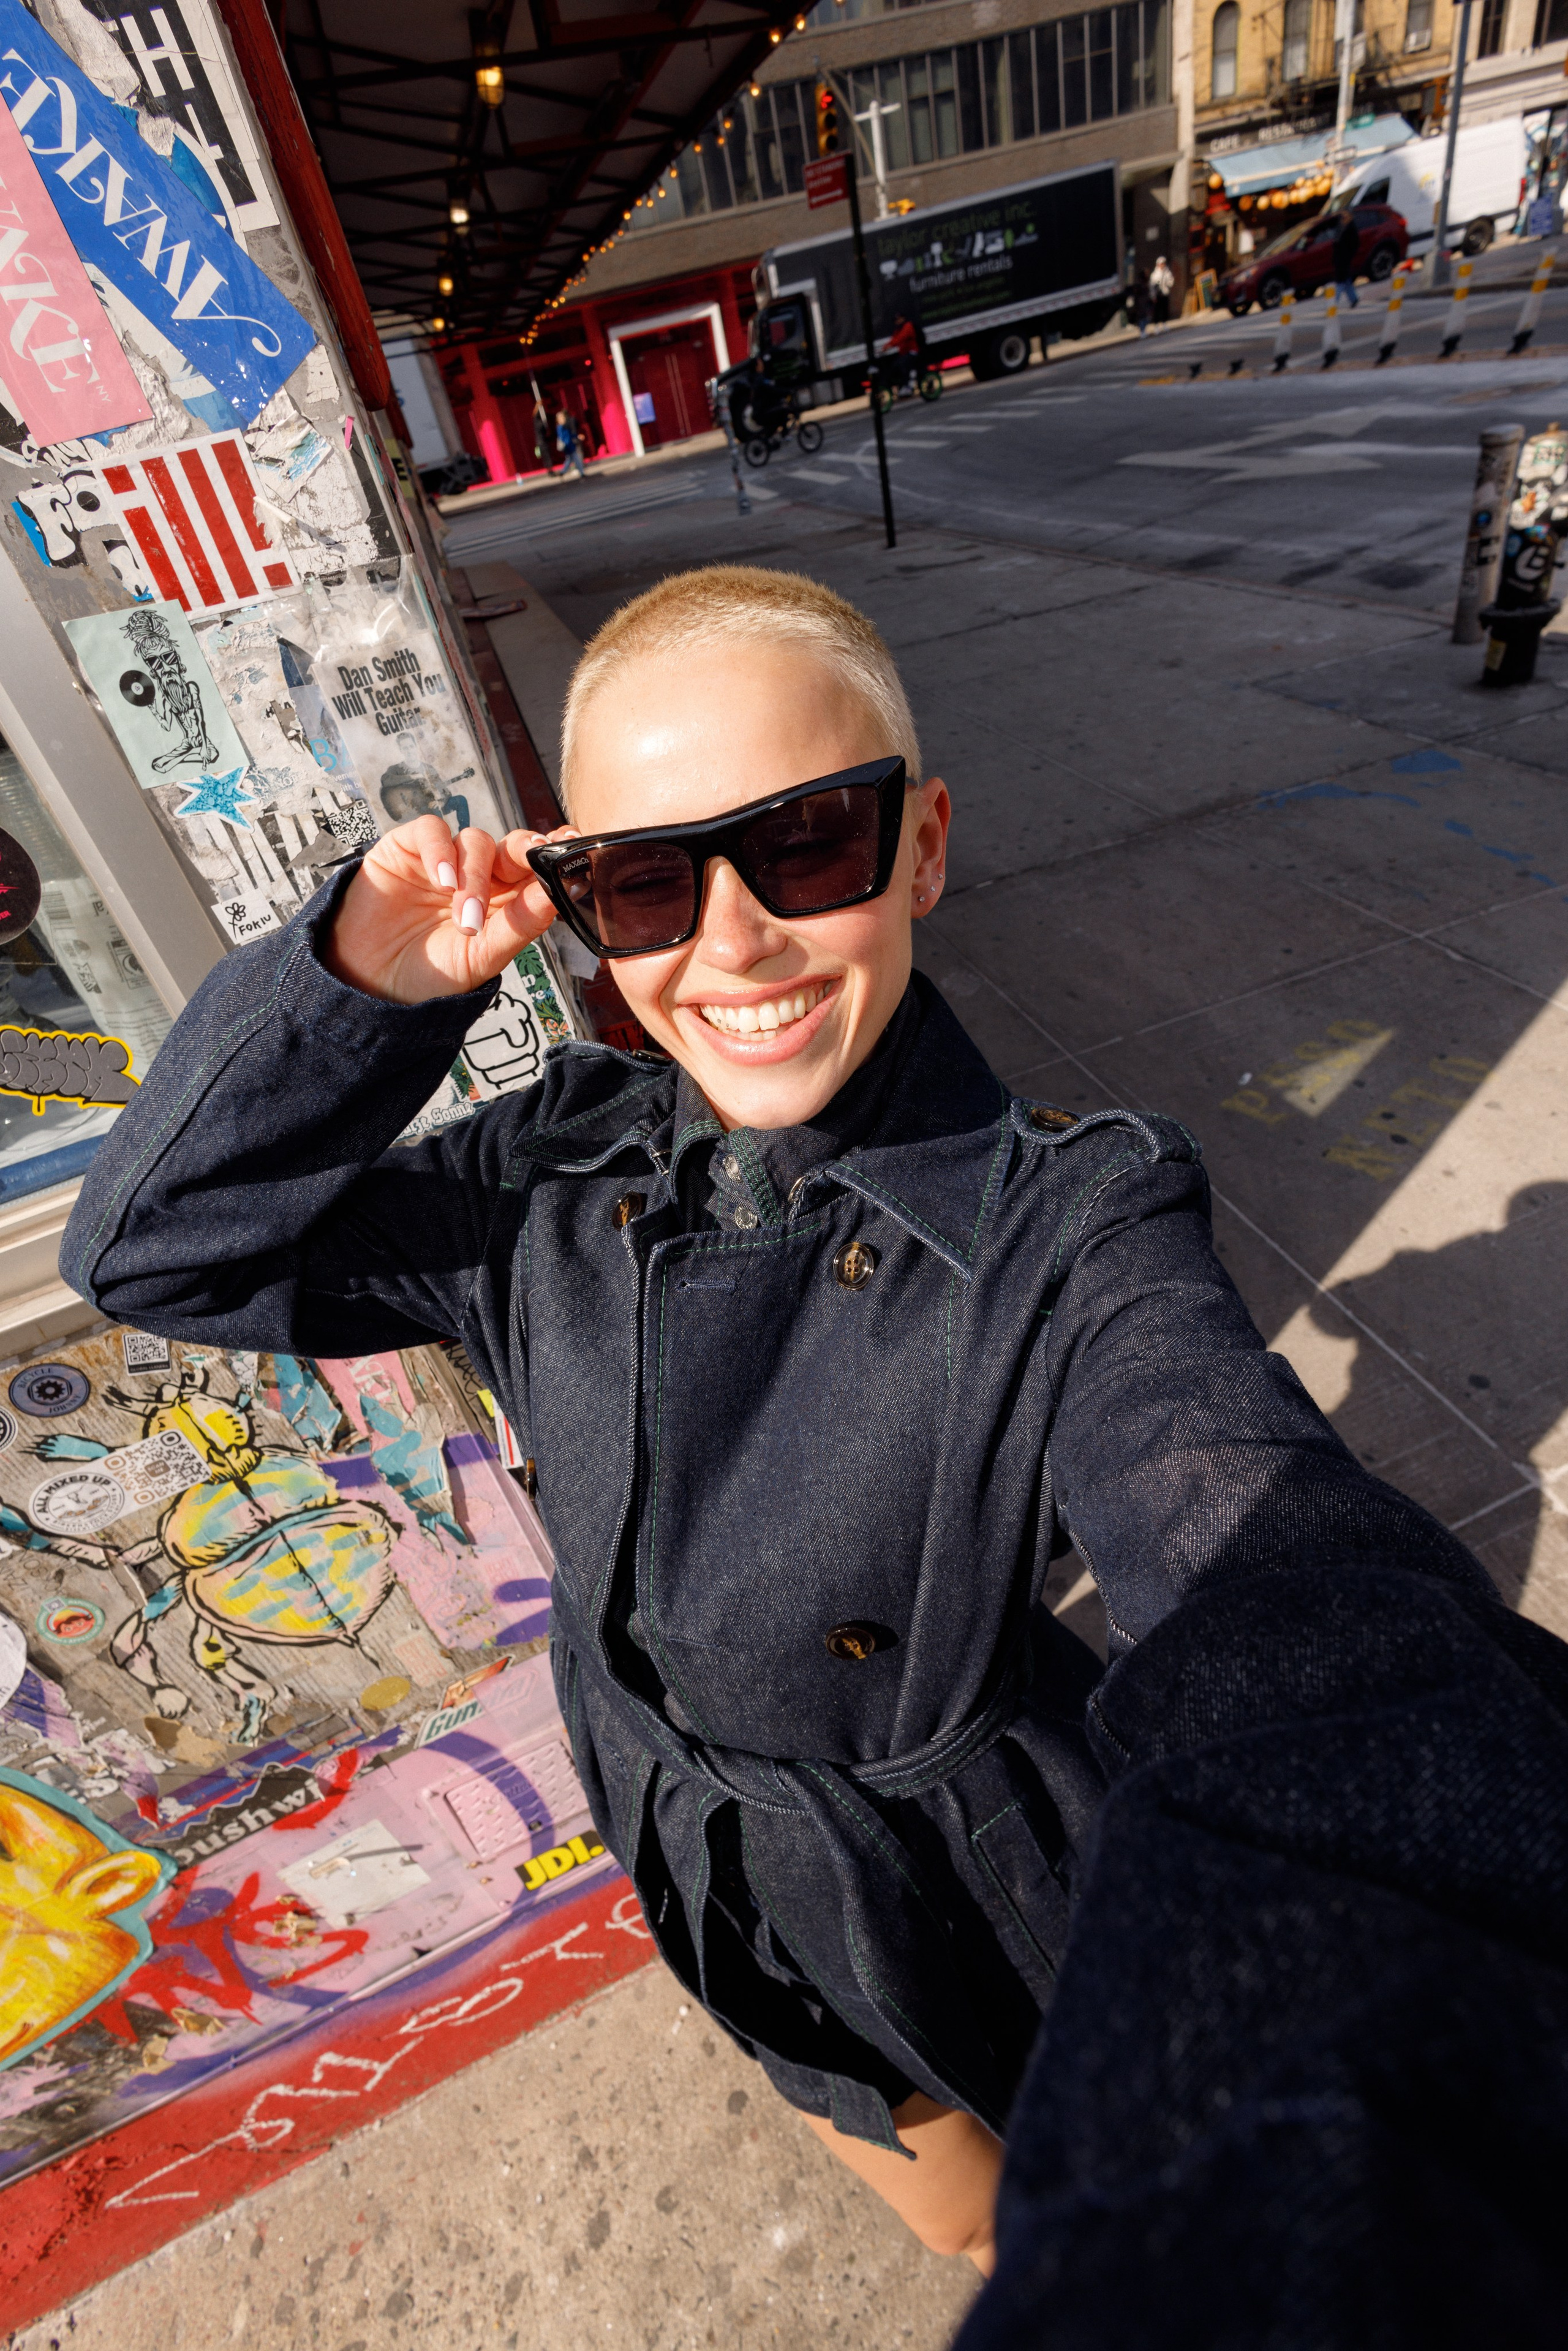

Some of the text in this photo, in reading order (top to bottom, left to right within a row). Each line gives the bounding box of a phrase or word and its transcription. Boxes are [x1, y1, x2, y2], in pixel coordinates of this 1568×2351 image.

[94, 384, 111, 403] NY
[337, 648, 420, 691] Dan Smith
[331, 690, 367, 720] Will
[363, 678, 414, 711] Teach
[411, 673, 446, 698] You
[432, 1101, 475, 1126] Sonne
[18, 1368, 53, 1389] BICYCLE
[48, 1394, 81, 1413] JOHNNY
[37, 1496, 48, 1513] ALL
[44, 1474, 89, 1495] MIXED
[92, 1474, 111, 1487] UP
[523, 1835, 605, 1891] JDI.
